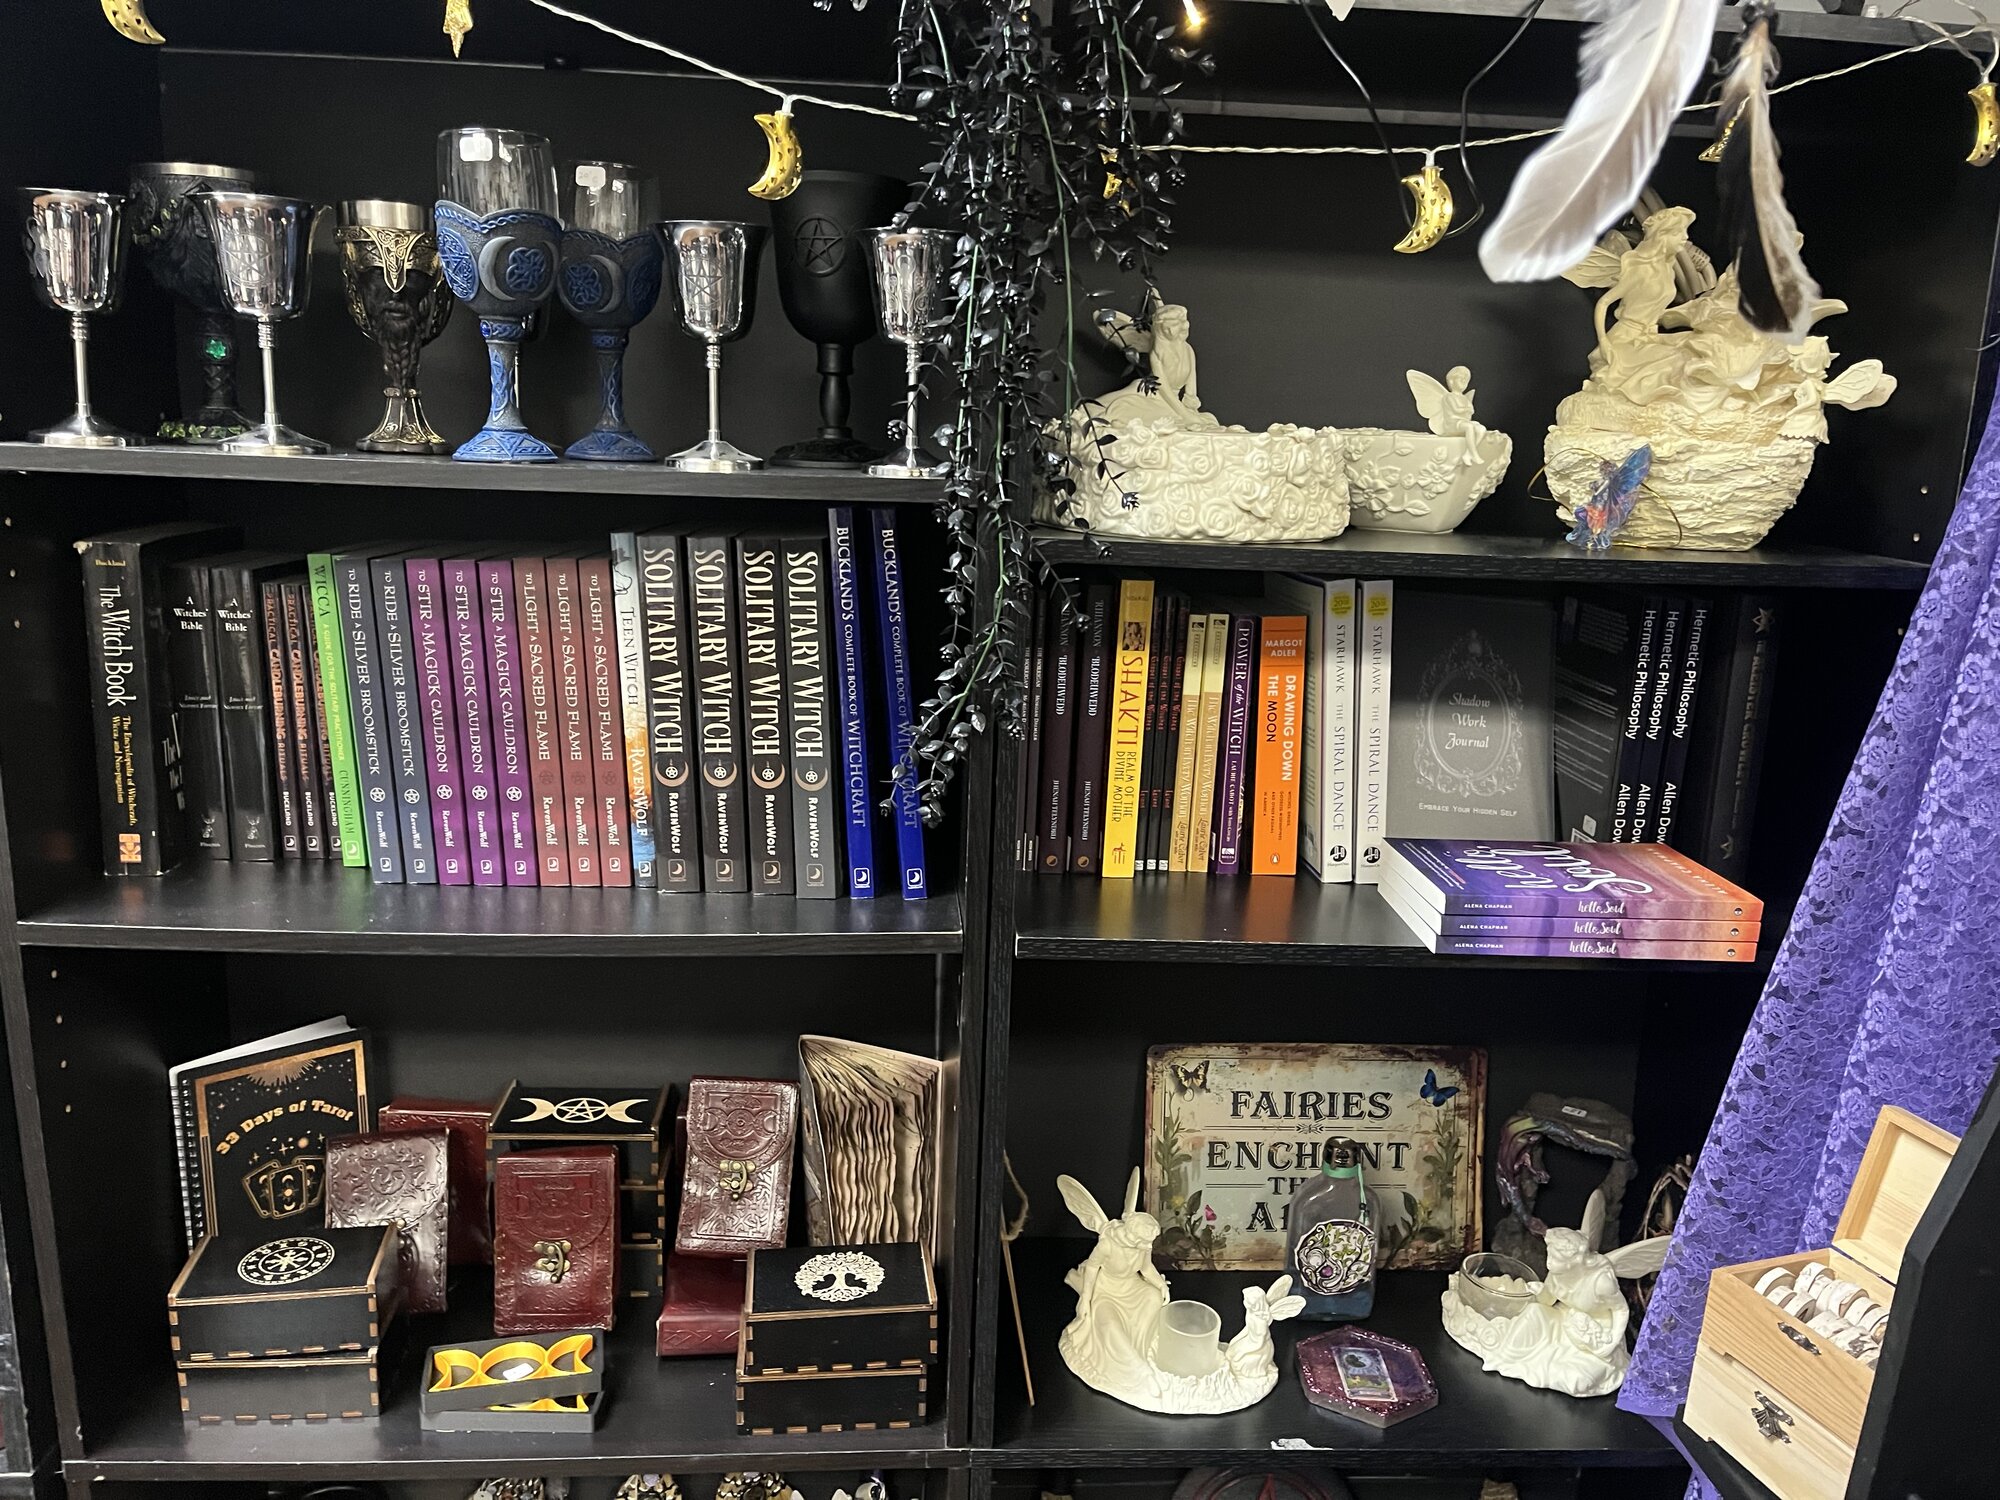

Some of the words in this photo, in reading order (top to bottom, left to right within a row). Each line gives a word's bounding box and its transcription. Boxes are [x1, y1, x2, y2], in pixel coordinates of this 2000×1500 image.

[99, 585, 121, 608] The
[313, 565, 330, 617] WICCA
[348, 568, 356, 581] TO
[418, 570, 426, 581] TO
[525, 573, 532, 584] TO
[836, 527, 854, 621] BUCKLAND'S
[881, 529, 901, 622] BUCKLAND'S
[173, 608, 208, 617] Witches'
[186, 596, 194, 605] A
[217, 609, 253, 619] Witches'
[229, 598, 238, 606] A
[348, 583, 362, 619] RIDE
[384, 585, 398, 621] RIDE
[418, 585, 433, 620] STIR
[455, 585, 470, 621] STIR
[524, 586, 539, 633] LIGHT
[557, 587, 573, 634] LIGHT
[643, 548, 678, 666] SOLITARY
[694, 549, 728, 667] SOLITARY
[743, 550, 777, 669] SOLITARY
[786, 551, 820, 670] SOLITARY
[102, 609, 134, 657] Witch
[180, 620, 203, 630] Bible
[225, 622, 248, 632] Bible
[844, 624, 855, 672] COMPLETE
[1265, 639, 1303, 647] MARGOT
[1637, 610, 1656, 669] Hermetic
[1659, 611, 1679, 669] Hermetic
[1686, 609, 1707, 668] Hermetic
[352, 630, 370, 684] SILVER
[388, 632, 406, 686] SILVER
[422, 631, 441, 696] MAGICK
[459, 632, 477, 697] MAGICK
[891, 627, 903, 673] COMPLETE
[1235, 628, 1250, 680] POWER
[1270, 649, 1297, 657] ADLER
[1336, 624, 1345, 693] STARHAWK
[1372, 626, 1382, 694] STARHAWK
[104, 662, 137, 707] Book
[270, 648, 287, 740] CANDLEBURNING
[291, 649, 308, 740] CANDLEBURNING
[529, 644, 546, 707] SACRED
[562, 644, 578, 708] SACRED
[624, 652, 639, 705] WITCH
[847, 675, 857, 702] BOOK
[896, 677, 906, 704] BOOK
[1056, 655, 1067, 715] BLODEUWEDD
[1088, 656, 1100, 716] BLODEUWEDD
[1234, 684, 1244, 694] of
[1267, 674, 1278, 696] THE
[650, 670, 684, 753] WITCH
[700, 671, 733, 753] WITCH
[749, 673, 781, 755] WITCH
[792, 675, 824, 758] WITCH
[850, 703, 857, 716] OF
[1117, 656, 1143, 745] SHAKTI
[1266, 701, 1278, 742] MOON
[1283, 675, 1296, 736] DRAWING
[1448, 692, 1491, 708] Shadow
[1452, 712, 1487, 728] Work
[1624, 671, 1648, 740] Philosophy
[1646, 672, 1670, 740] Philosophy
[1673, 670, 1697, 739] Philosophy
[361, 689, 381, 775] BROOMSTICK
[395, 691, 415, 776] BROOMSTICK
[431, 699, 449, 773] CAULDRON
[466, 700, 484, 774] CAULDRON
[535, 710, 550, 760] FLAME
[567, 710, 582, 761] FLAME
[1229, 708, 1244, 754] WITCH
[1333, 726, 1345, 775] SPIRAL
[1368, 728, 1380, 776] SPIRAL
[1445, 732, 1489, 750] Journal
[847, 719, 866, 827] WITCHCRAFT
[1114, 752, 1125, 782] DIVINE
[1125, 752, 1136, 782] REALM
[1282, 741, 1294, 781] DOWN
[283, 791, 292, 826] BUCKLAND
[305, 791, 314, 826] BUCKLAND
[339, 770, 355, 834] CUNNINGHAM
[1112, 785, 1123, 823] MOTHER
[1123, 800, 1134, 817] THE
[1125, 786, 1134, 798] OF
[1333, 781, 1345, 831] DANCE
[1367, 783, 1379, 832] DANCE
[1616, 783, 1631, 816] Allen
[1636, 783, 1651, 816] Allen
[1661, 782, 1677, 815] Allen
[376, 811, 388, 848] RavenWolf
[410, 812, 422, 849] RavenWolf
[442, 810, 454, 847] RavenWolf
[477, 811, 489, 848] RavenWolf
[543, 797, 558, 845] RavenWolf
[575, 797, 589, 846] RavenWolf
[668, 792, 681, 854] RAVENWOLF
[717, 792, 729, 854] RAVENWOLF
[765, 794, 777, 856] RAVENWOLF
[808, 797, 820, 859] RAVENWOLF
[1599, 922, 1621, 935] Soul
[1603, 901, 1625, 914] Soul
[240, 1106, 284, 1133] Days
[289, 1099, 308, 1113] of
[311, 1100, 354, 1122] Tarot
[1230, 1090, 1393, 1122] FAIRIES
[1206, 1140, 1413, 1172] ENCHNT
